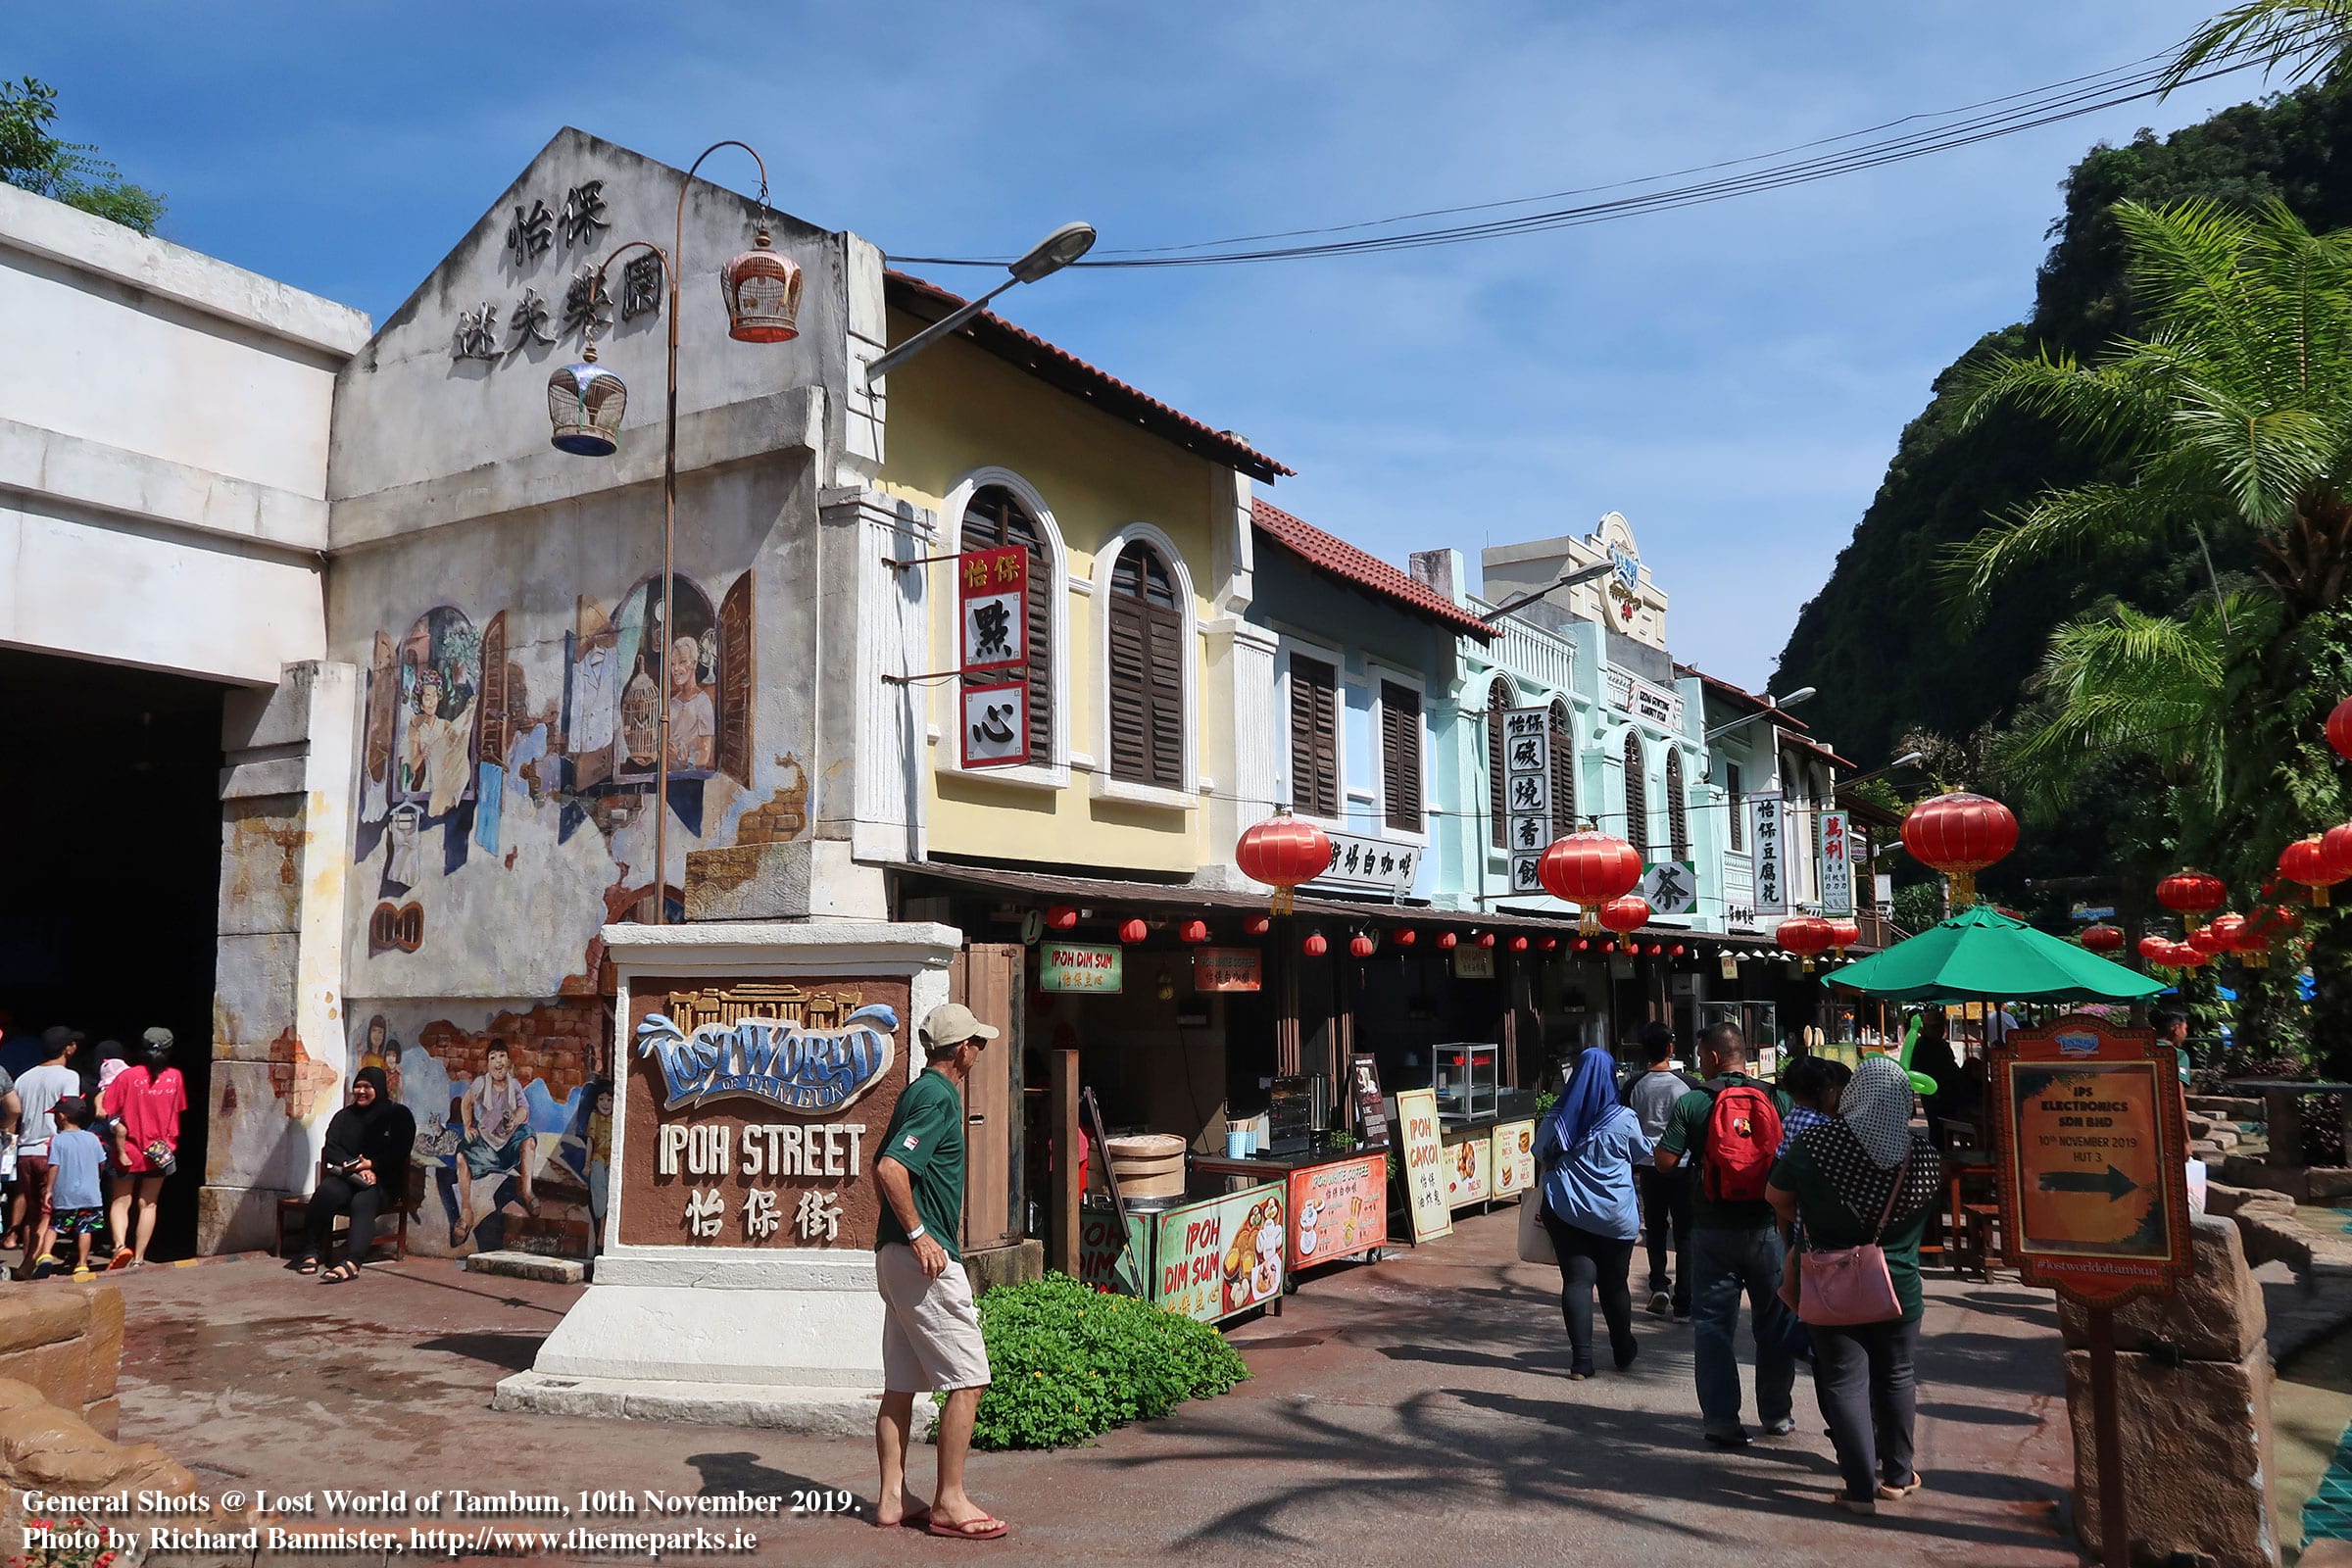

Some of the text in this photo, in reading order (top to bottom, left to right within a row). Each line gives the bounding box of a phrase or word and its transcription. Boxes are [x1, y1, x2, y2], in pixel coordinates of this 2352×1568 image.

[507, 179, 611, 267] 怡保
[963, 554, 1020, 588] 怡保
[972, 599, 1014, 744] 點心
[1508, 713, 1544, 733] 怡保
[1757, 799, 1780, 903] 怡保豆腐花
[1825, 816, 1843, 860] 萬利
[1651, 866, 1690, 910] 茶
[1052, 950, 1112, 969] IPOH DIM SUM
[653, 1024, 884, 1103] LOST WORLD
[722, 1077, 847, 1108] OF TAMBUN
[2041, 1101, 2129, 1112] ELECTRONICS
[2074, 1087, 2093, 1098] IPS
[1409, 1117, 1432, 1142] IPOH
[2059, 1116, 2113, 1128] SDN BHD
[660, 1124, 866, 1177] IPOH STREET
[1410, 1144, 1439, 1169] CAKOI
[2059, 1136, 2109, 1148] NOVEMBER
[2112, 1138, 2137, 1149] 2019
[2074, 1152, 2102, 1162] HUT 3
[686, 1188, 844, 1242] 怡保街
[1185, 1215, 1221, 1255] IPOH
[1164, 1250, 1220, 1295] DIM SUM
